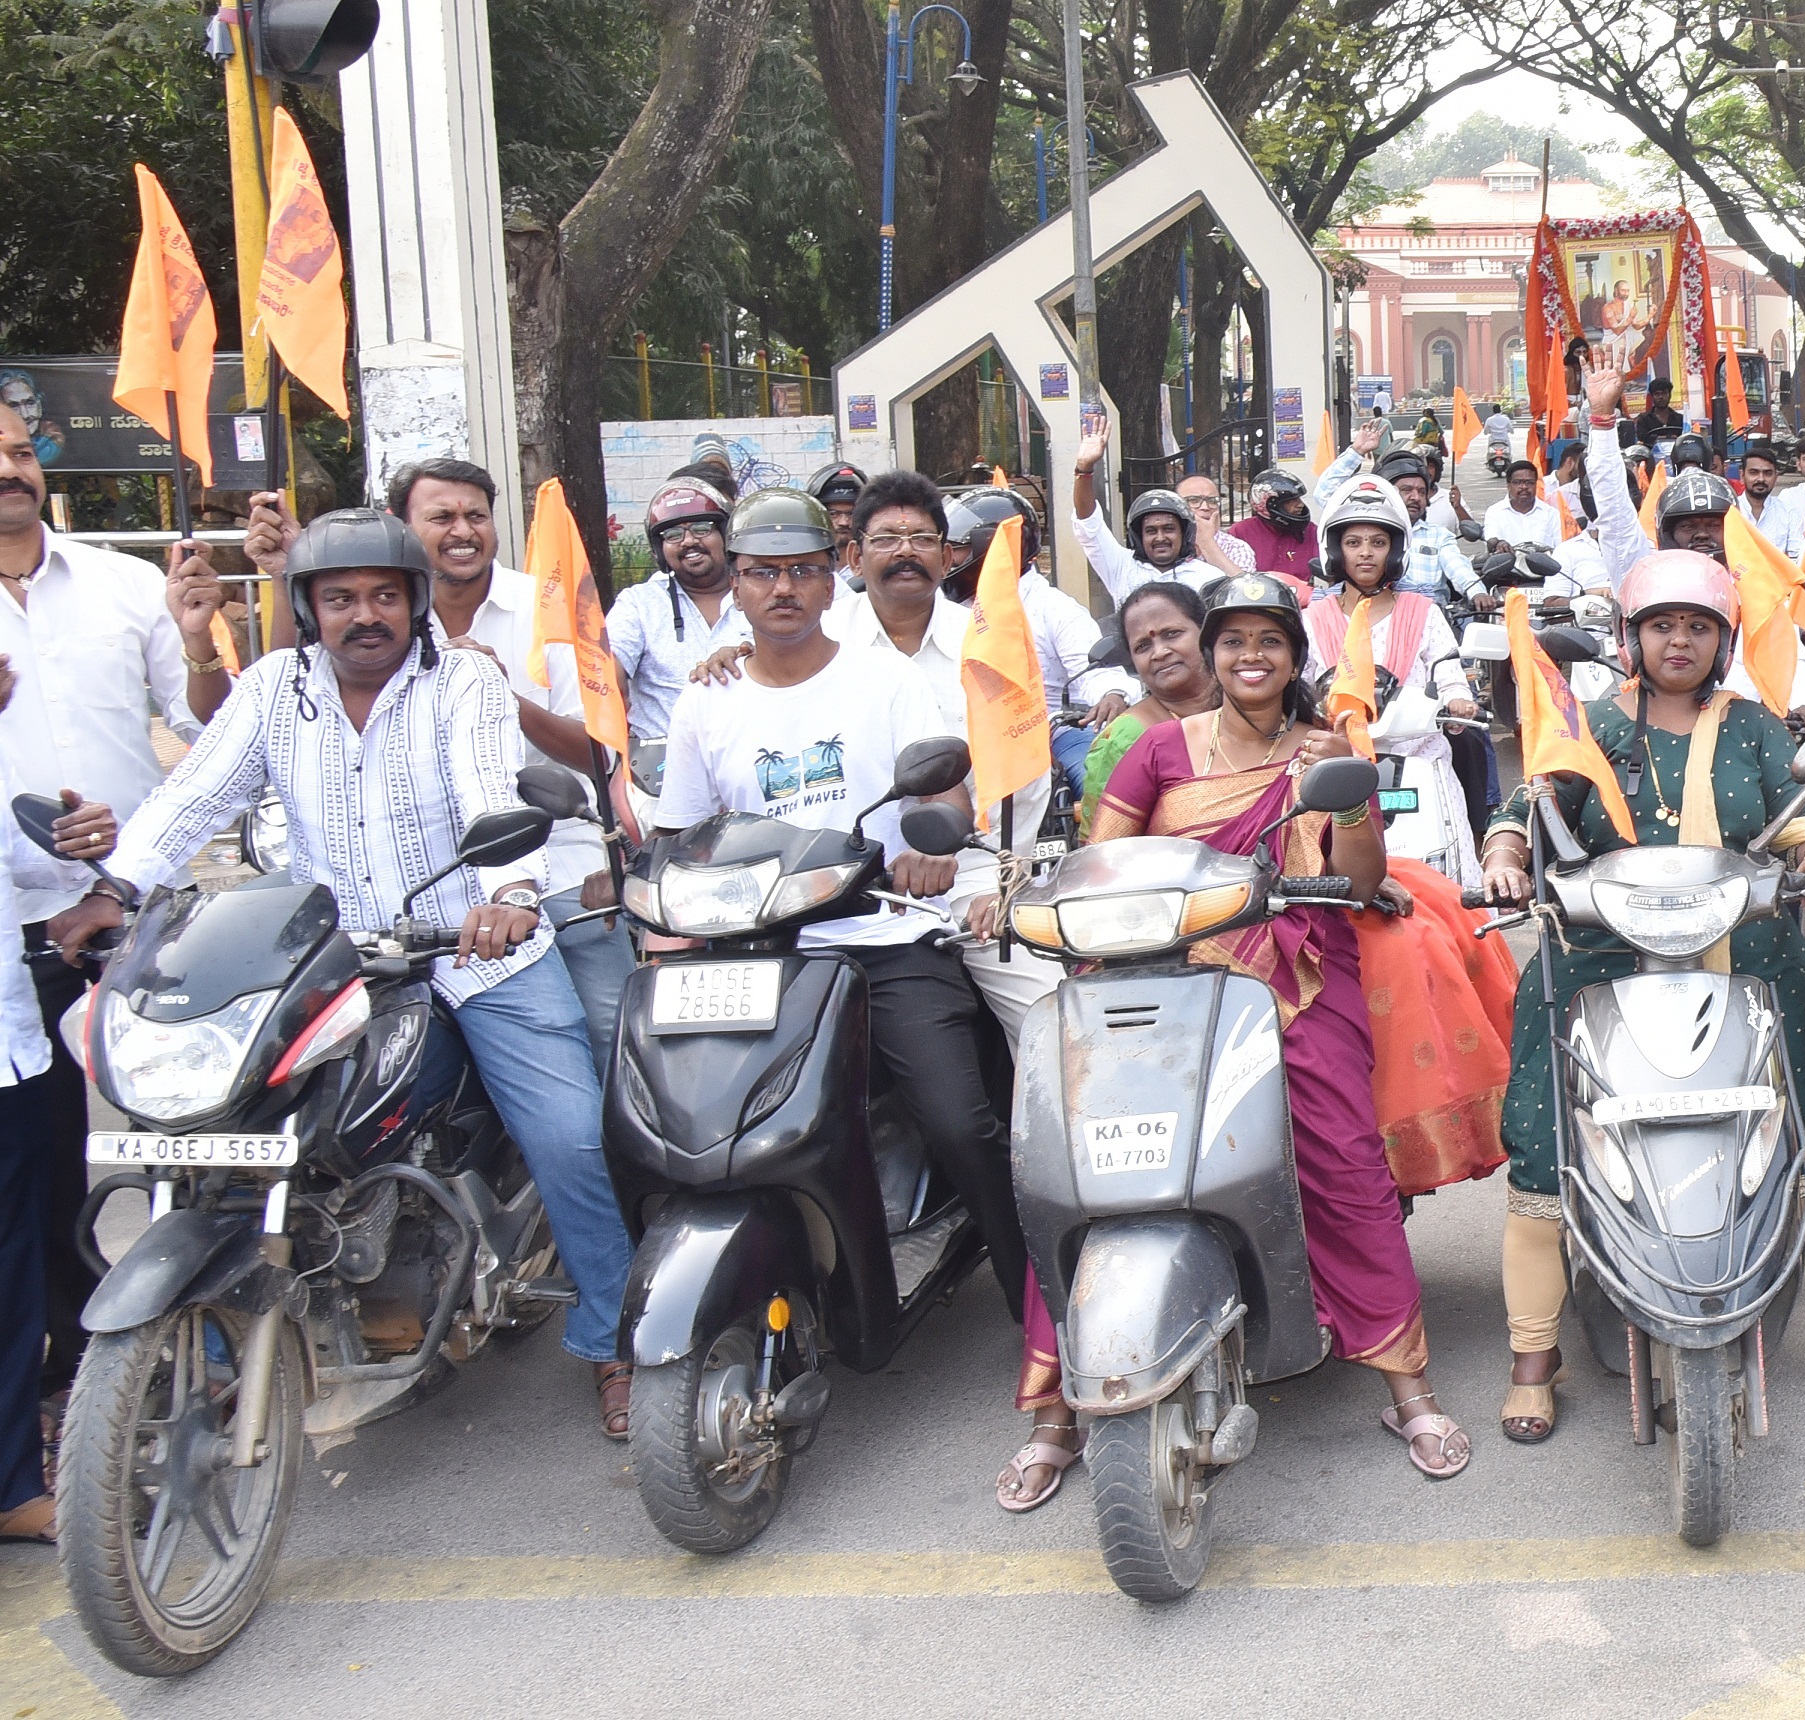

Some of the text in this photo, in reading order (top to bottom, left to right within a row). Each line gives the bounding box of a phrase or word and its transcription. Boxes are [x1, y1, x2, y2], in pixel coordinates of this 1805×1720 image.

[803, 788, 847, 807] WAVES
[1660, 983, 1688, 995] TVS
[677, 994, 752, 1020] Z8566
[1621, 1089, 1771, 1116] KA 06EY 2613
[116, 1138, 288, 1162] KA 06EJ 5657
